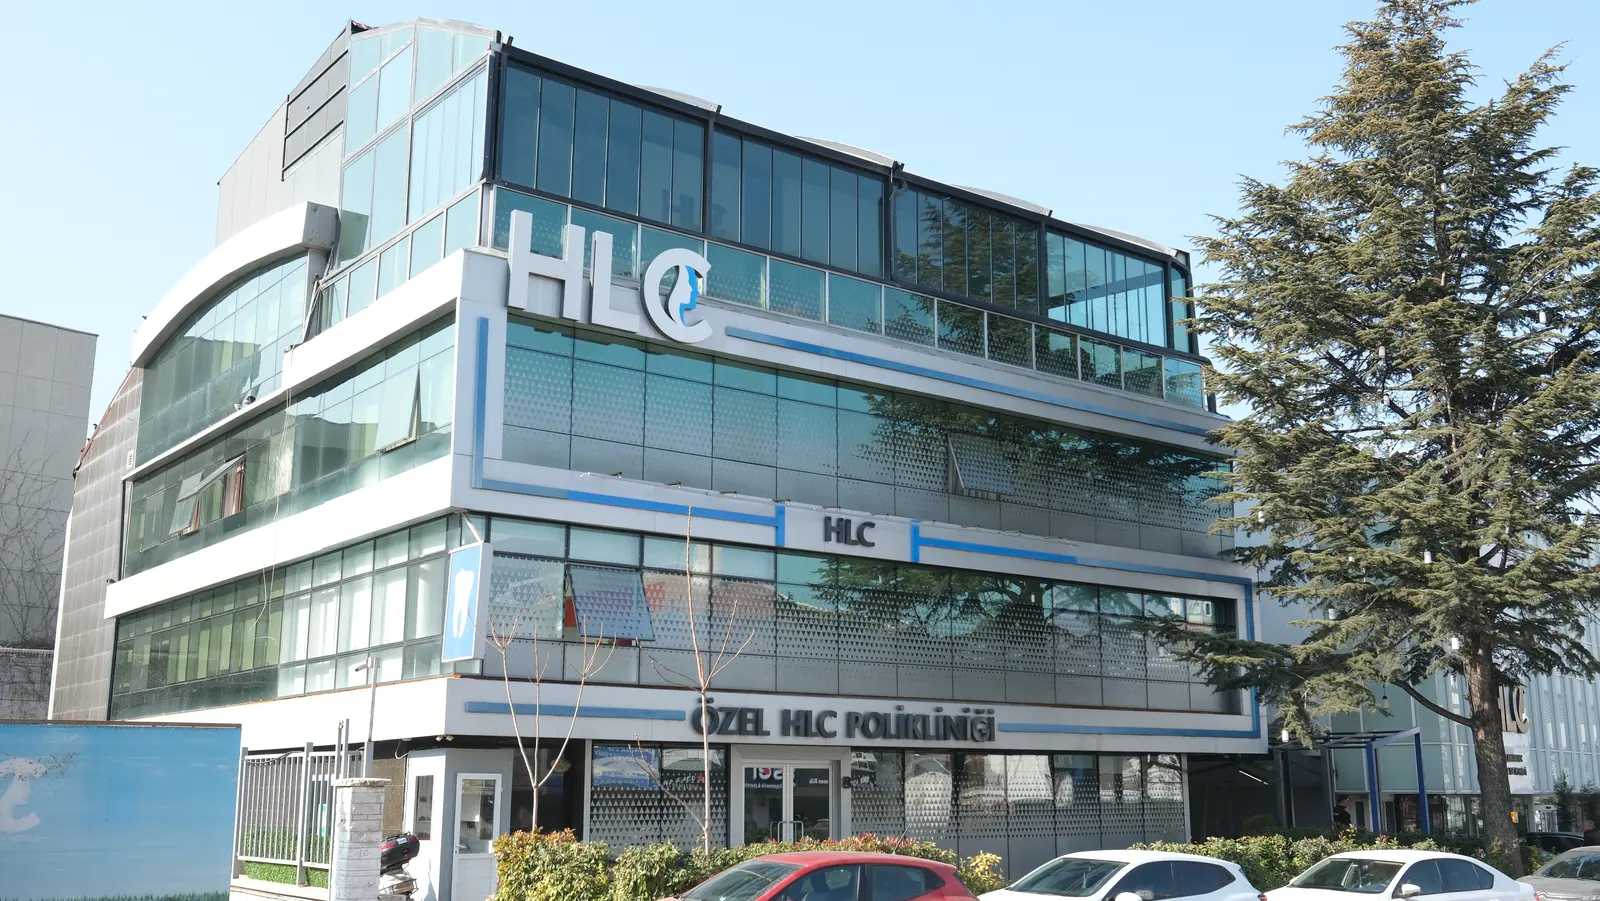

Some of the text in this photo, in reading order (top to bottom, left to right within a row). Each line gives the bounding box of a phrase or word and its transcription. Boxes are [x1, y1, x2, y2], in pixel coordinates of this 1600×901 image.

[508, 209, 713, 344] HLC
[823, 515, 876, 547] HLC
[692, 696, 996, 742] ÖZEL HLC POLİKLİNİĞİ
